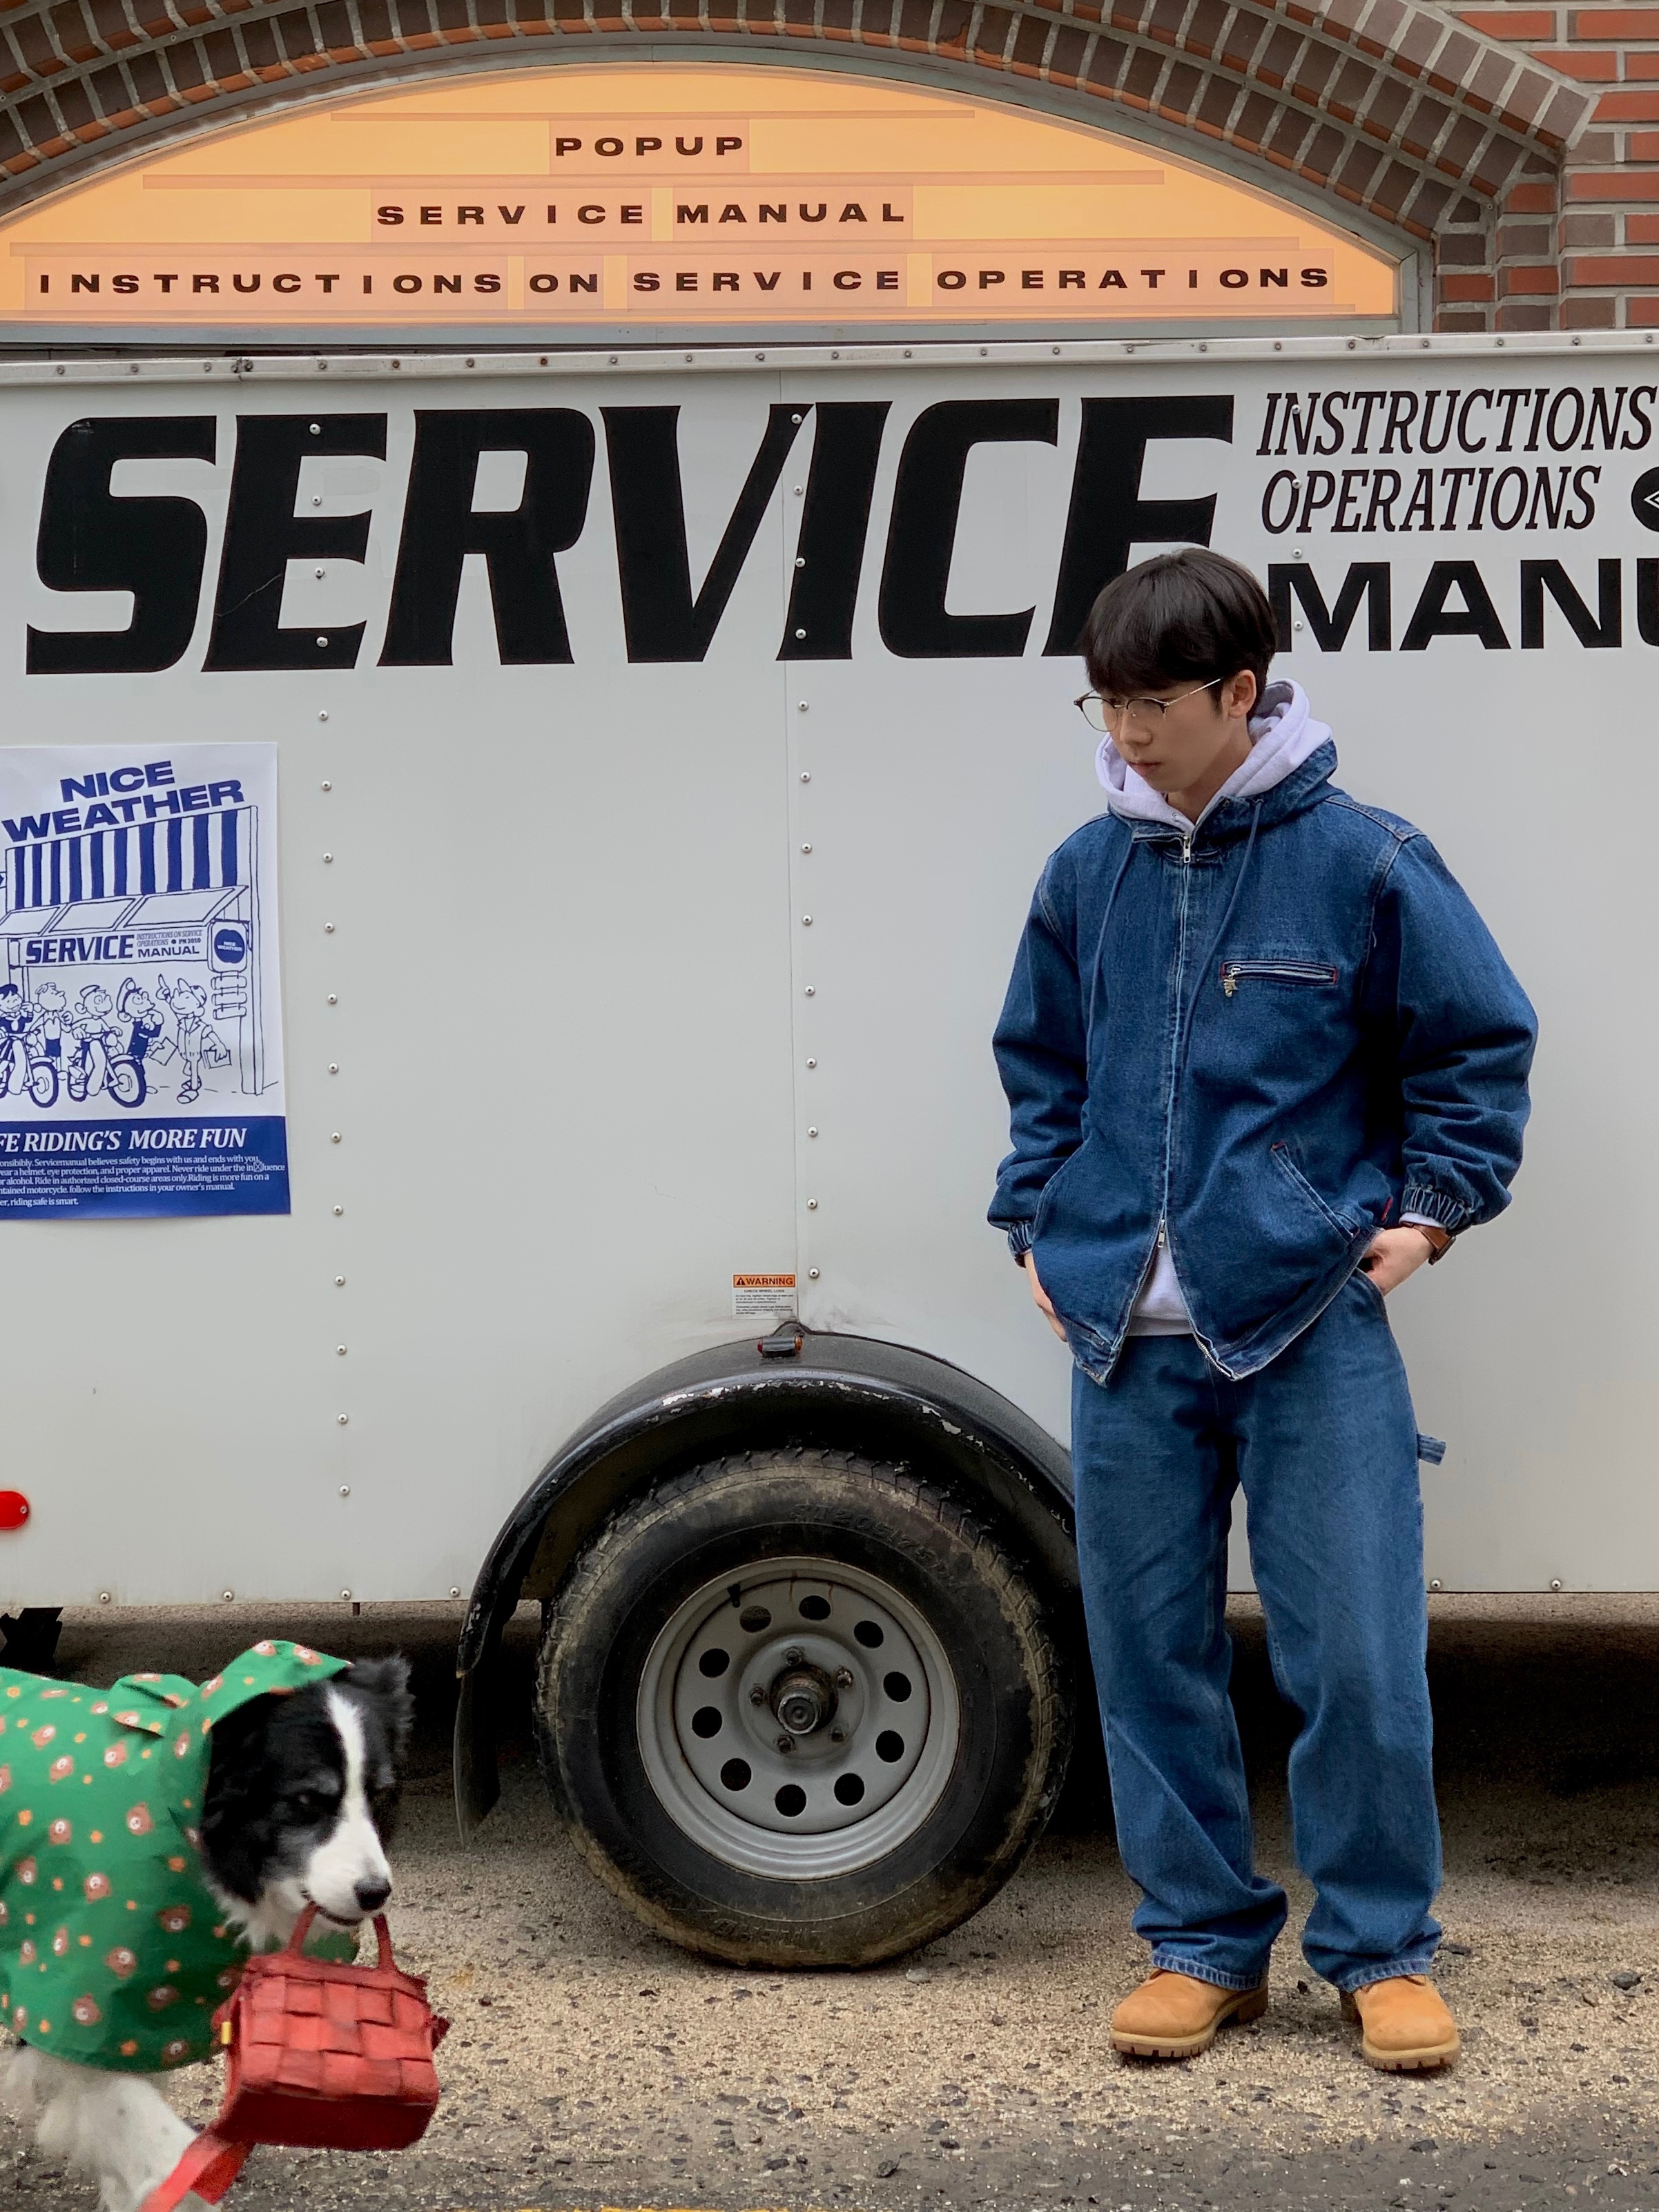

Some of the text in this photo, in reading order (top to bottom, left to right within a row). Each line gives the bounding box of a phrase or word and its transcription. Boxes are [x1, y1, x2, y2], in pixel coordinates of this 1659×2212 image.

[555, 136, 743, 157] POPUP
[376, 202, 904, 226] SERVICE MANUAL
[39, 267, 1329, 295] INSTRUCTIONS ON SERVICE OPERATIONS
[1256, 385, 1659, 456] INSTRUCTIONS
[1261, 465, 1602, 534] OPERATIONS
[26, 395, 1234, 675] SERVICE
[1268, 558, 1659, 652] MAN
[59, 760, 175, 802] NICE
[1, 779, 244, 842] WEATHER
[137, 931, 173, 940] INSTRUCTIONS
[137, 938, 168, 947] OPERATIONS
[26, 934, 135, 964] SERVICE
[138, 946, 200, 958] MANUAL
[22, 1130, 122, 1152] RIDING'S
[128, 1129, 197, 1150] MORE
[200, 1128, 247, 1149] FUN
[35, 1158, 87, 1167] Servicemanual
[88, 1157, 117, 1165] believes
[119, 1156, 140, 1166] safety
[141, 1156, 165, 1165] begins
[193, 1155, 207, 1163] and
[208, 1154, 225, 1163] ends
[226, 1154, 244, 1163] with
[47, 1169, 59, 1177] eye
[115, 1167, 141, 1176] proper
[172, 1165, 194, 1173] Never
[195, 1164, 208, 1172] ride
[210, 1164, 233, 1172] under
[233, 1163, 246, 1172] the
[6, 1176, 34, 1185] alcohol.
[35, 1176, 51, 1185] Ride
[61, 1175, 99, 1184] authorized
[100, 1174, 150, 1183] closed-course
[69, 1185, 91, 1193] follow
[93, 1185, 104, 1193] the
[105, 1184, 148, 1193] instructions
[149, 1183, 156, 1192] in
[157, 1184, 175, 1193] your
[175, 1183, 204, 1192] owner's
[10, 1198, 32, 1207] riding
[33, 1197, 48, 1205] safe
[746, 1277, 793, 1286] WARNING
